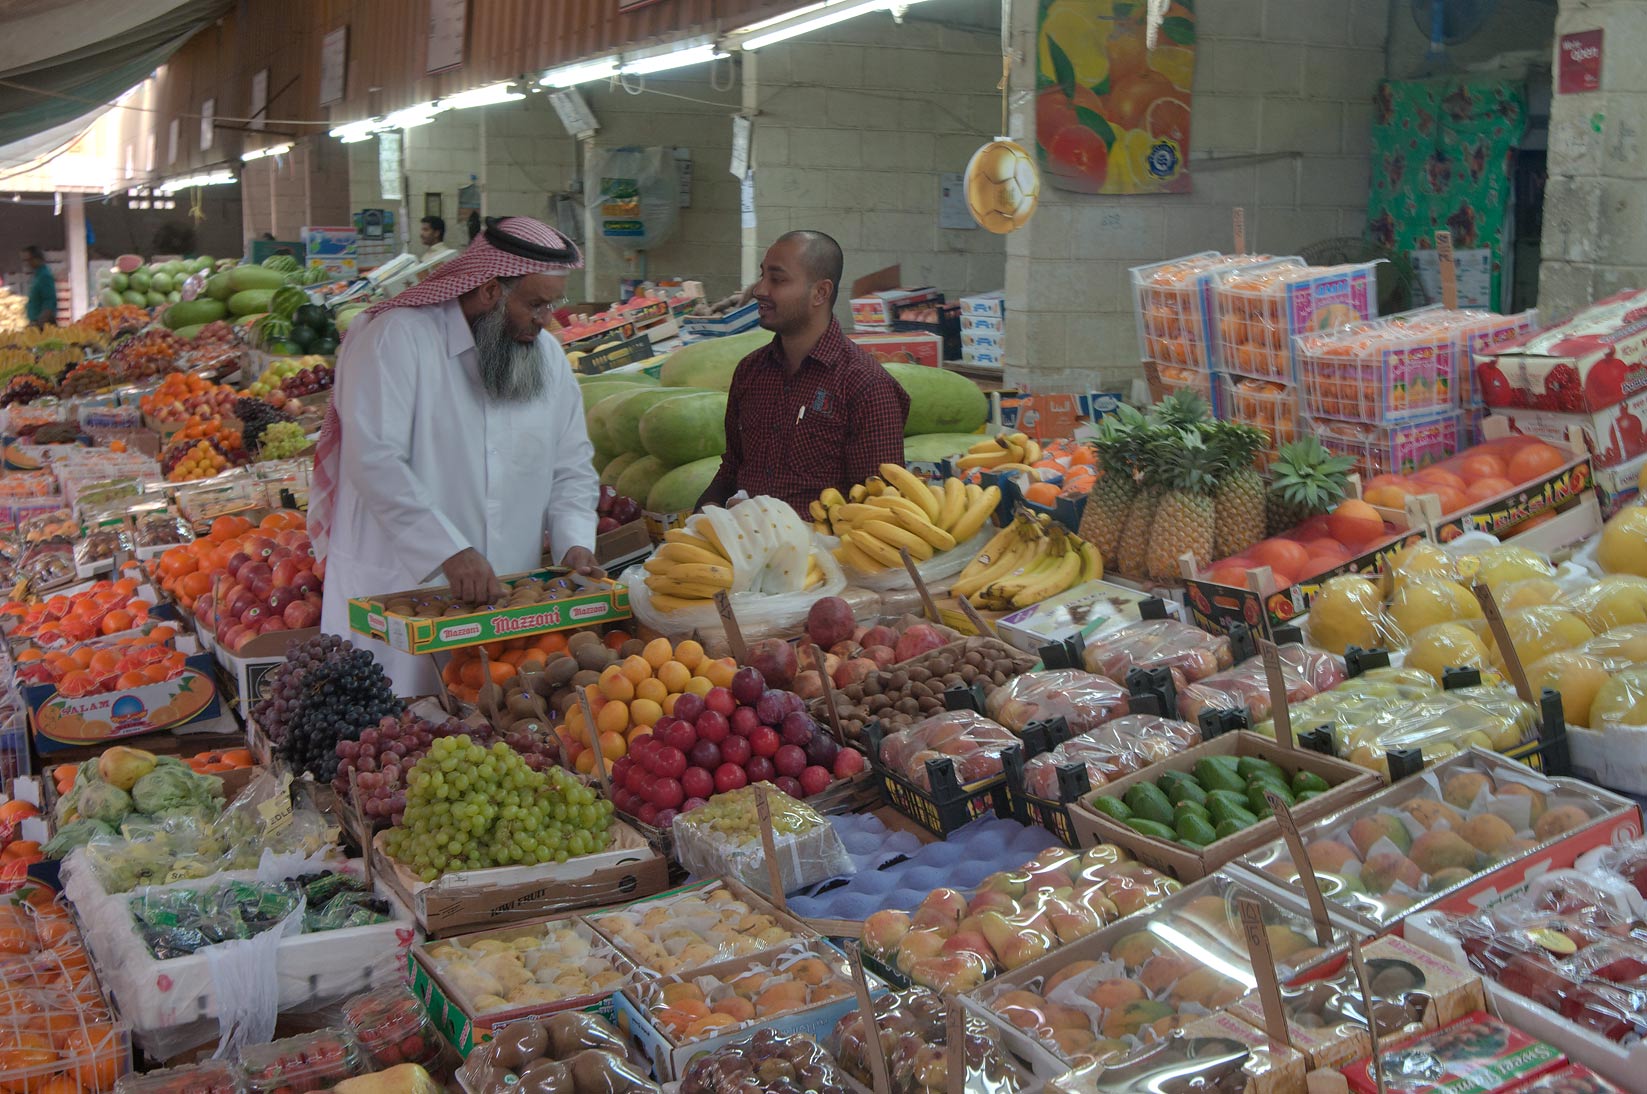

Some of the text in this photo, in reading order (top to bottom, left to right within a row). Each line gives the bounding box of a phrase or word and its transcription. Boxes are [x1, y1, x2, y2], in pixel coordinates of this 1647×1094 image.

[572, 603, 607, 617] Mazzoni
[490, 606, 561, 635] Mazzoni
[442, 625, 480, 640] Mazzoni
[61, 700, 109, 716] SALAM
[490, 888, 548, 918] KIWI FRUIT
